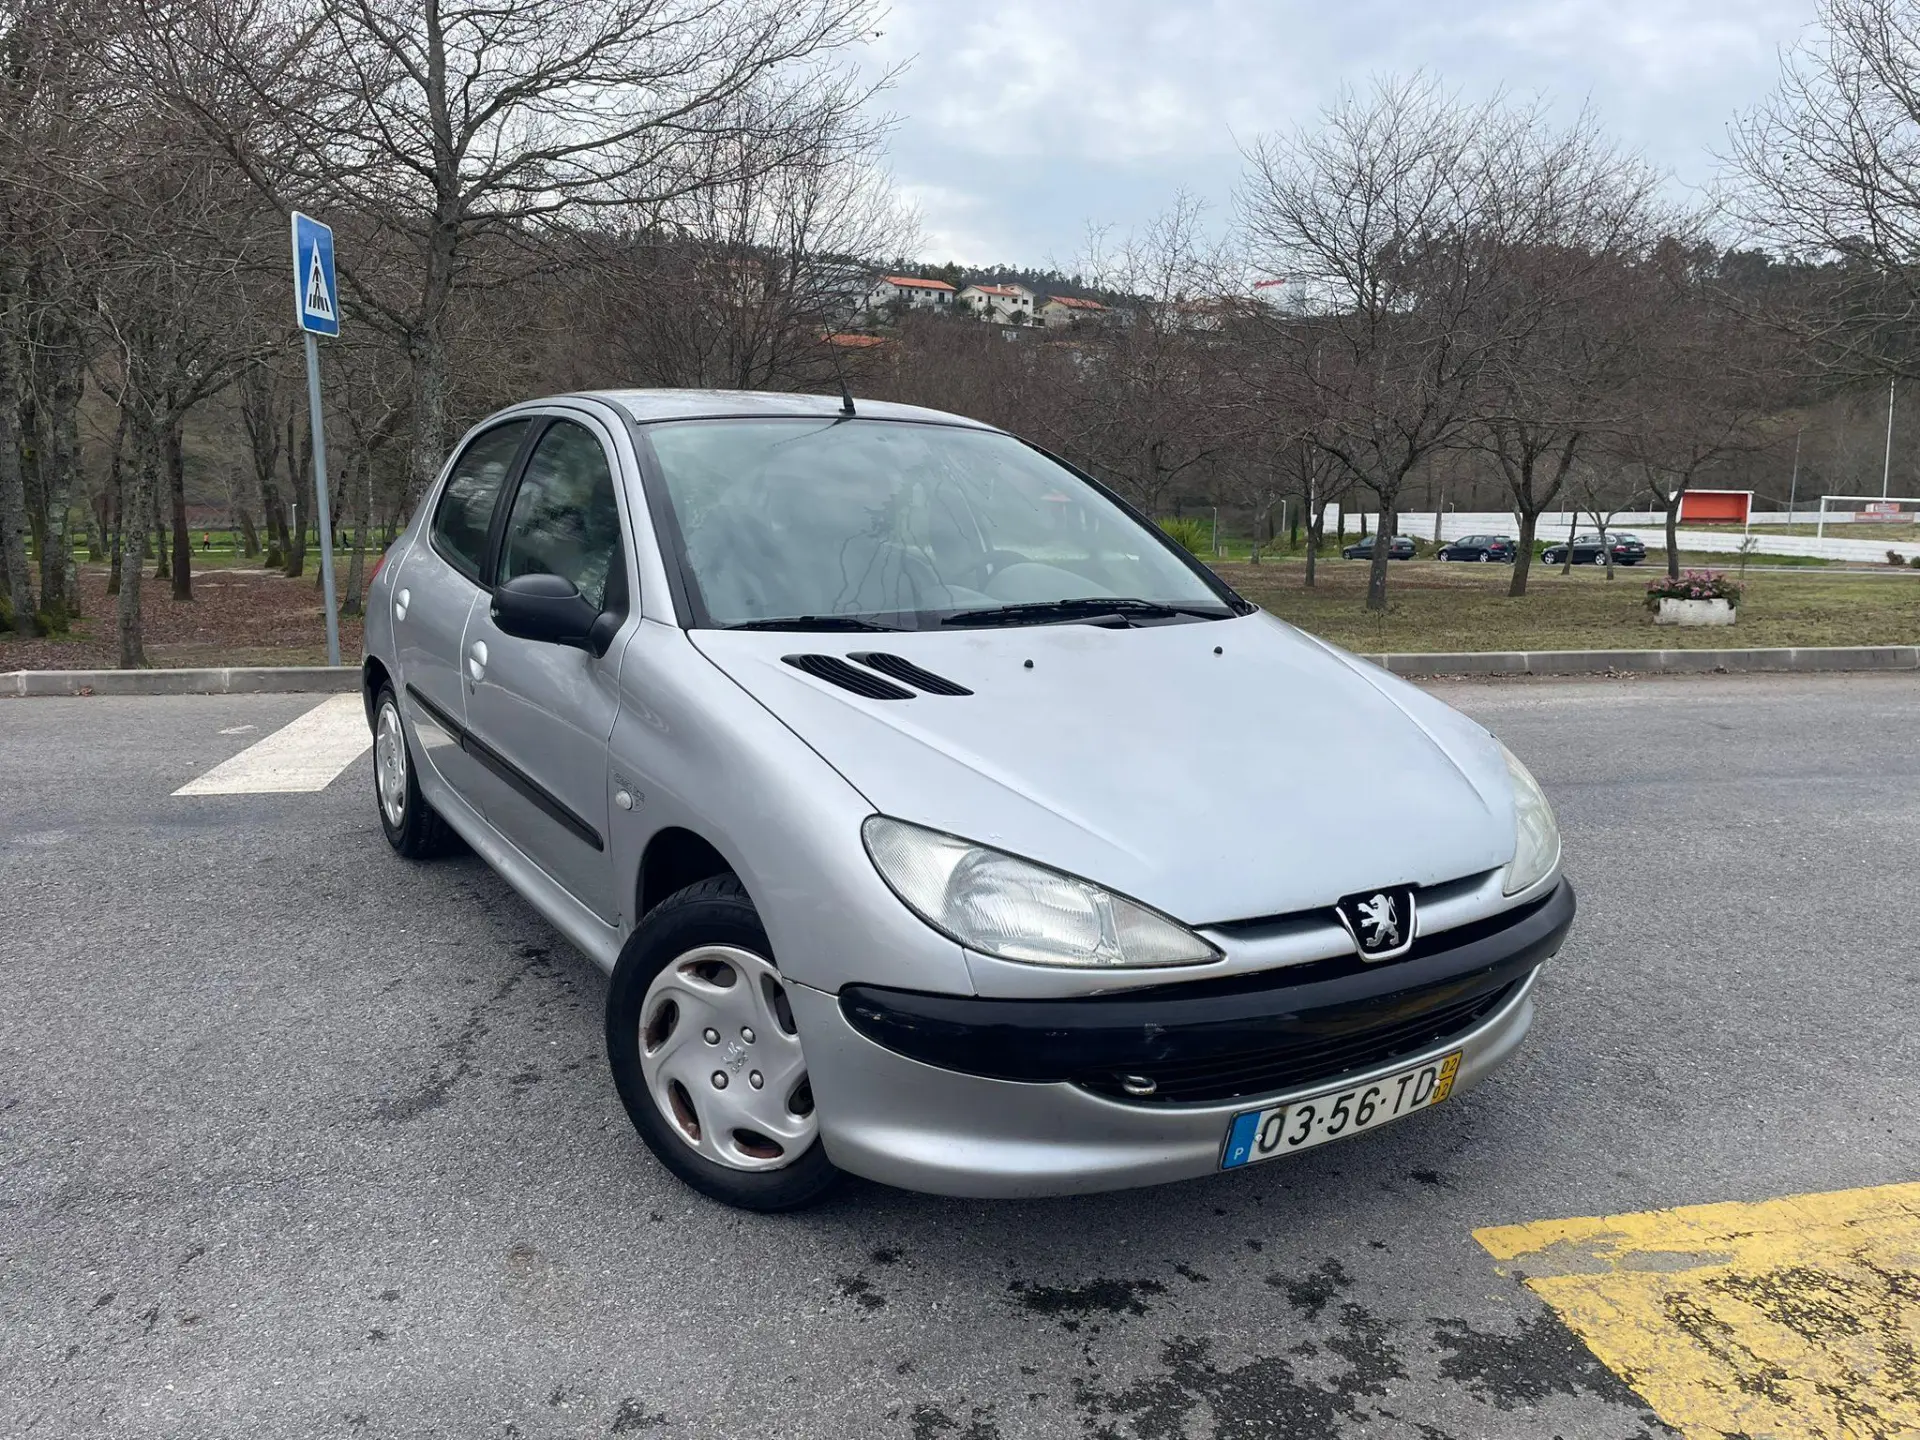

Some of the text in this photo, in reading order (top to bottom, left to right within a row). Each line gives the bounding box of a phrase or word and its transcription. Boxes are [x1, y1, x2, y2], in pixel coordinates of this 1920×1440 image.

[1441, 1057, 1457, 1074] 02
[1433, 1082, 1449, 1098] 02
[1234, 1147, 1244, 1160] P
